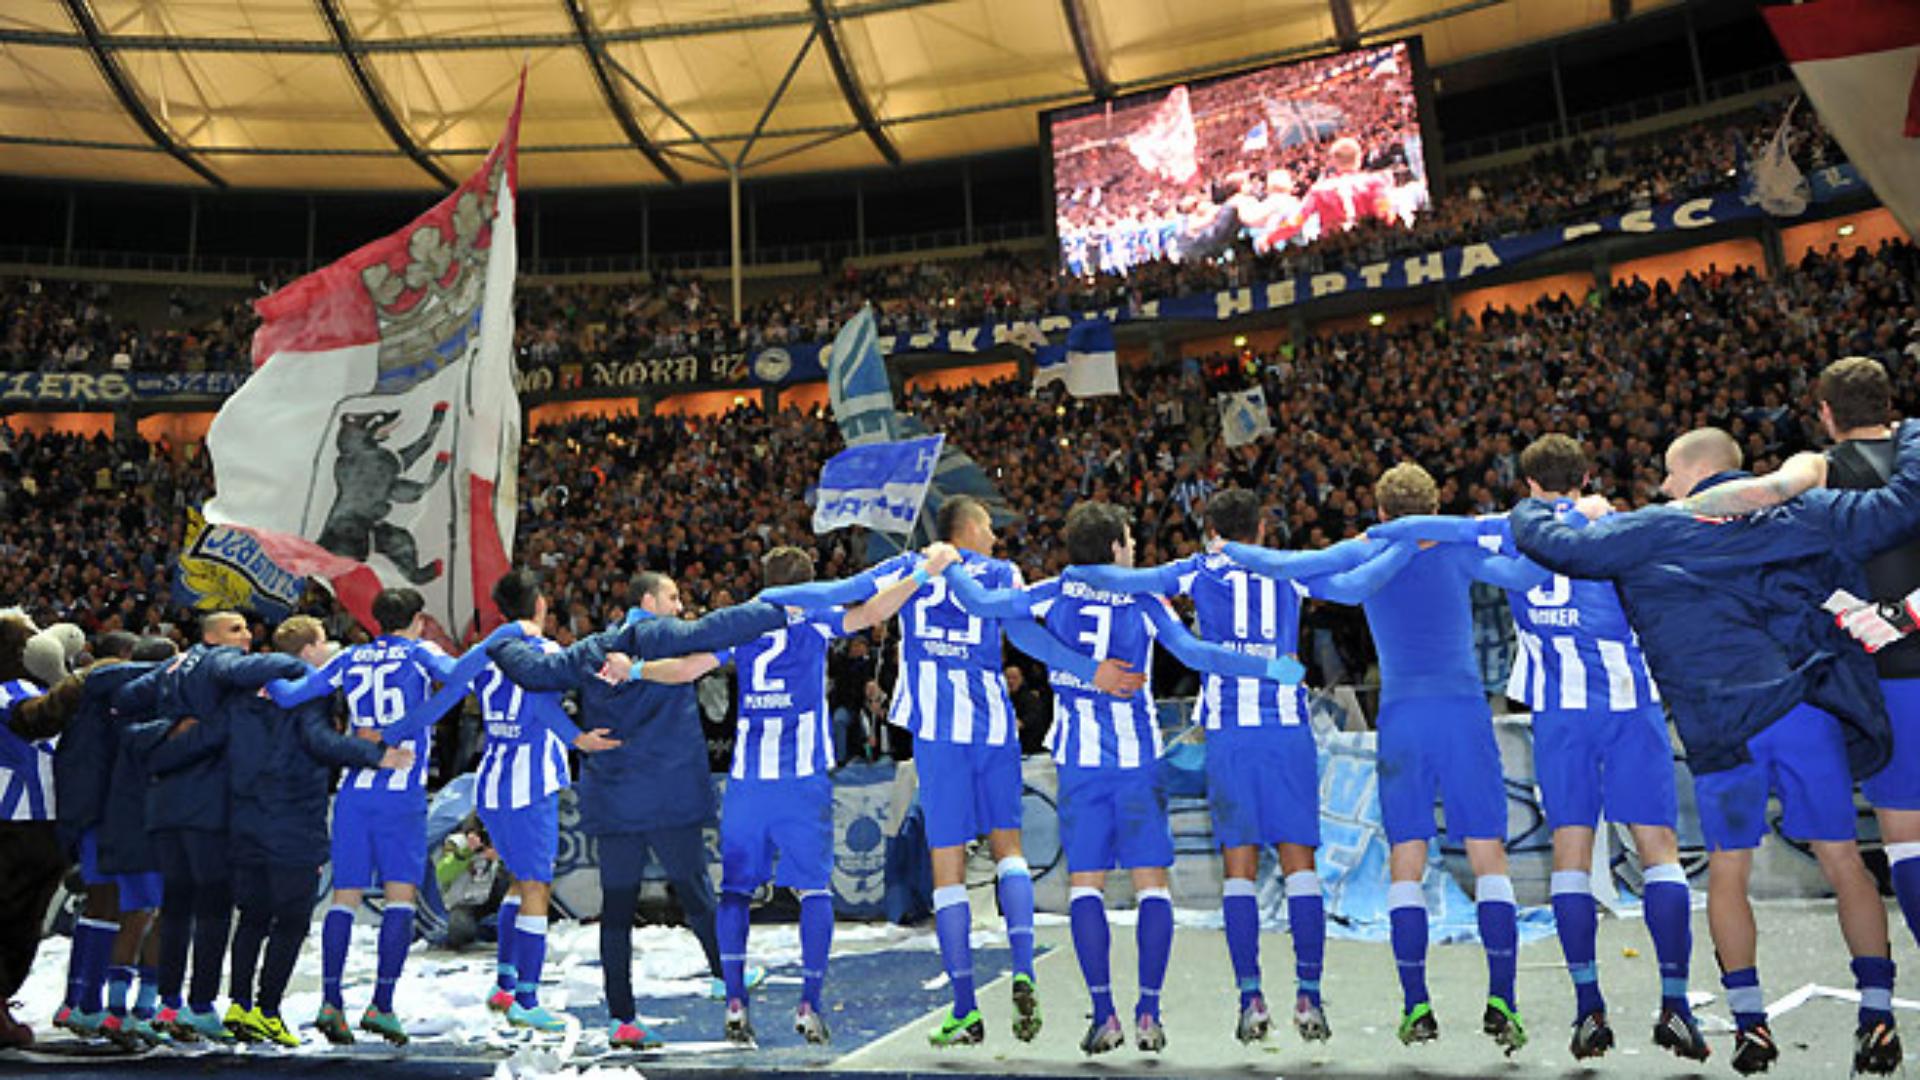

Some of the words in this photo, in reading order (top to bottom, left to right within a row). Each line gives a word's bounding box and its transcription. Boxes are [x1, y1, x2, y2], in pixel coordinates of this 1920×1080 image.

[1215, 242, 1501, 320] HERTHA
[1223, 570, 1277, 639] 11
[348, 661, 405, 727] 26
[752, 630, 787, 691] 2
